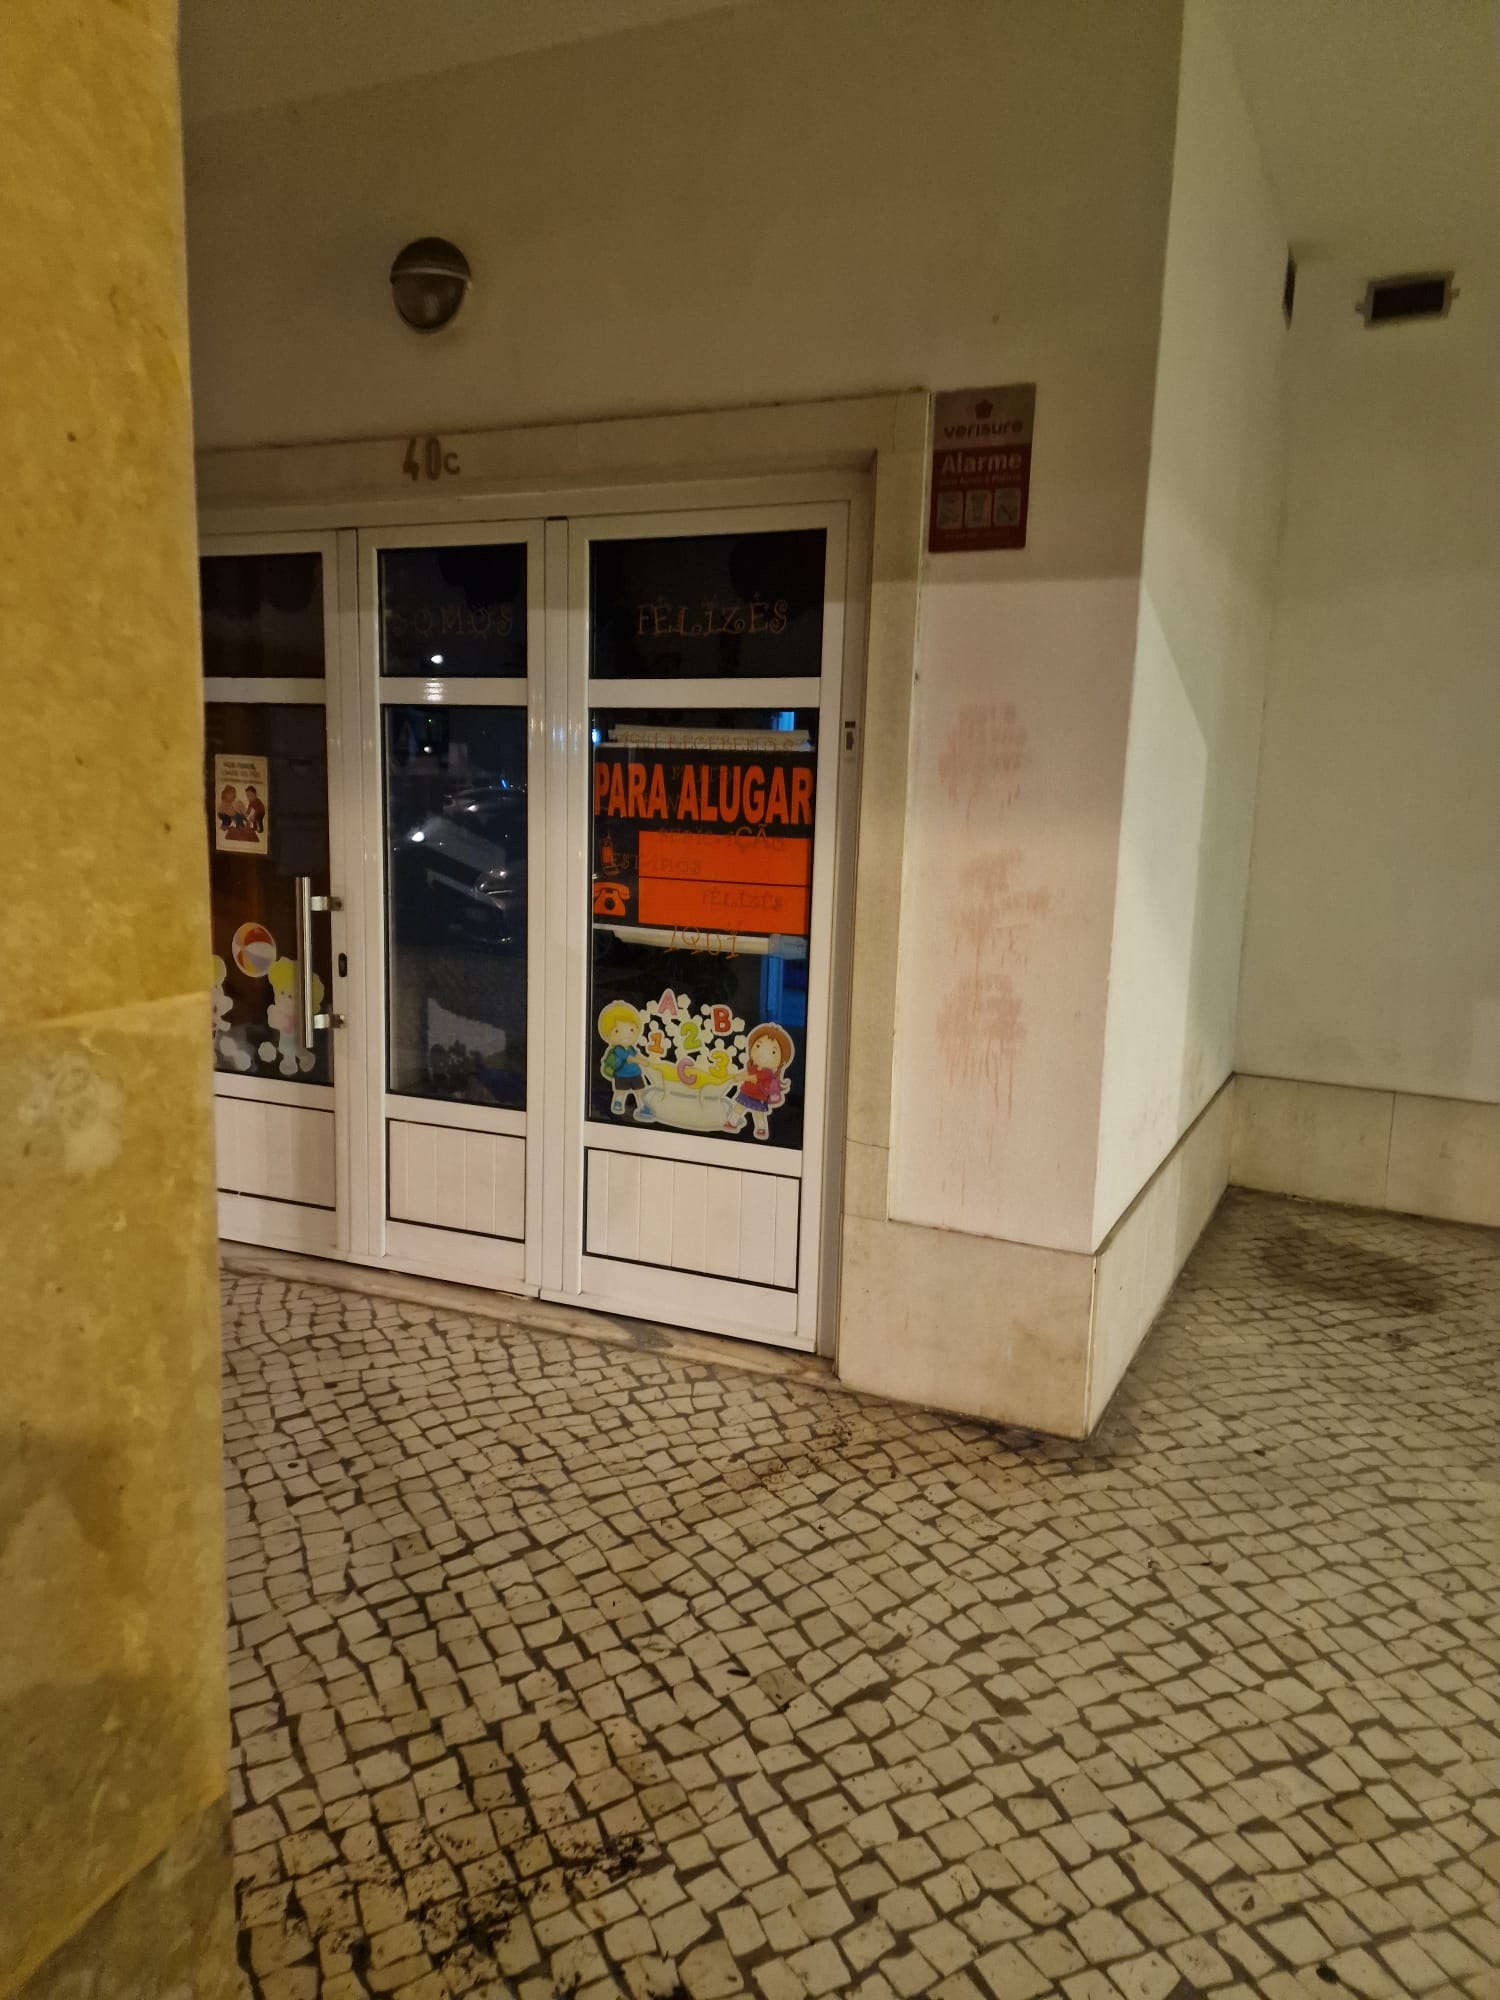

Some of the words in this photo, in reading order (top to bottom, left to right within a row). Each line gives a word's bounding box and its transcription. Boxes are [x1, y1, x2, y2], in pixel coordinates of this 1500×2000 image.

[944, 420, 1024, 440] verisure
[941, 452, 1023, 476] Alarme
[594, 761, 669, 820] PARA
[677, 764, 814, 826] ALUGAR
[658, 991, 678, 1016] A
[713, 1007, 732, 1033] B
[648, 1033, 665, 1054] 1
[680, 1021, 700, 1050] 2
[677, 1058, 698, 1085] C
[709, 1051, 730, 1079] 3
